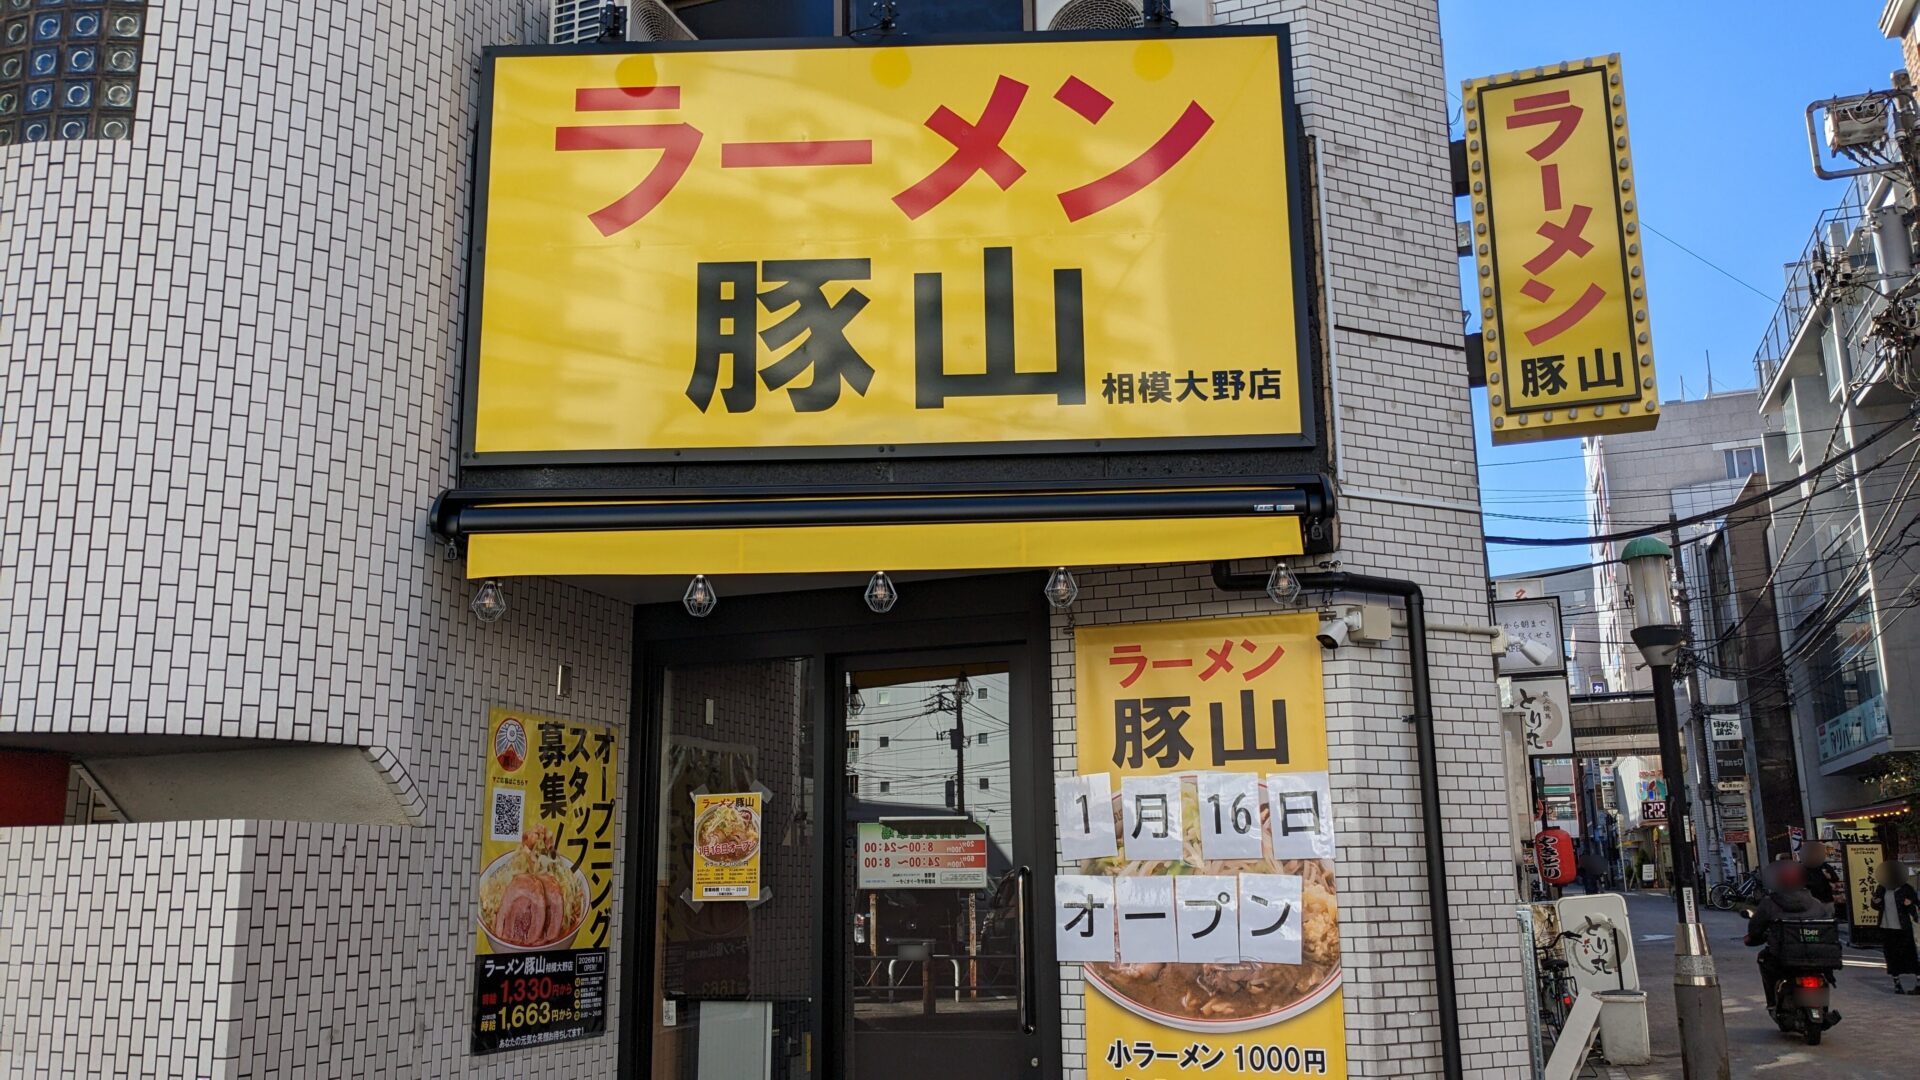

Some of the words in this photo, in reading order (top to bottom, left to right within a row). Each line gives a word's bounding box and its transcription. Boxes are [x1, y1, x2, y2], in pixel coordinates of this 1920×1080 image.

[555, 75, 1214, 237] ラーメン
[1506, 90, 1606, 346] ラーメン
[685, 246, 1086, 414] 豚山
[1102, 368, 1281, 404] 相模大野店
[1521, 348, 1624, 397] 豚山
[1109, 639, 1285, 688] ラーメン
[1112, 689, 1289, 768] 豚山
[1519, 688, 1544, 750] とり丸
[567, 727, 591, 873] スタッフ
[703, 797, 754, 808] ラーメン豚山
[1076, 791, 1321, 839] 1月16日
[590, 728, 615, 948] オープニング
[699, 841, 756, 856] 1月16日オープン
[1064, 891, 1291, 939] オープン
[485, 955, 546, 977] ラーメン豚山
[480, 1020, 496, 1032] 時給
[1106, 1039, 1225, 1070] 小ラーメン
[1233, 1044, 1327, 1074] 1000円
